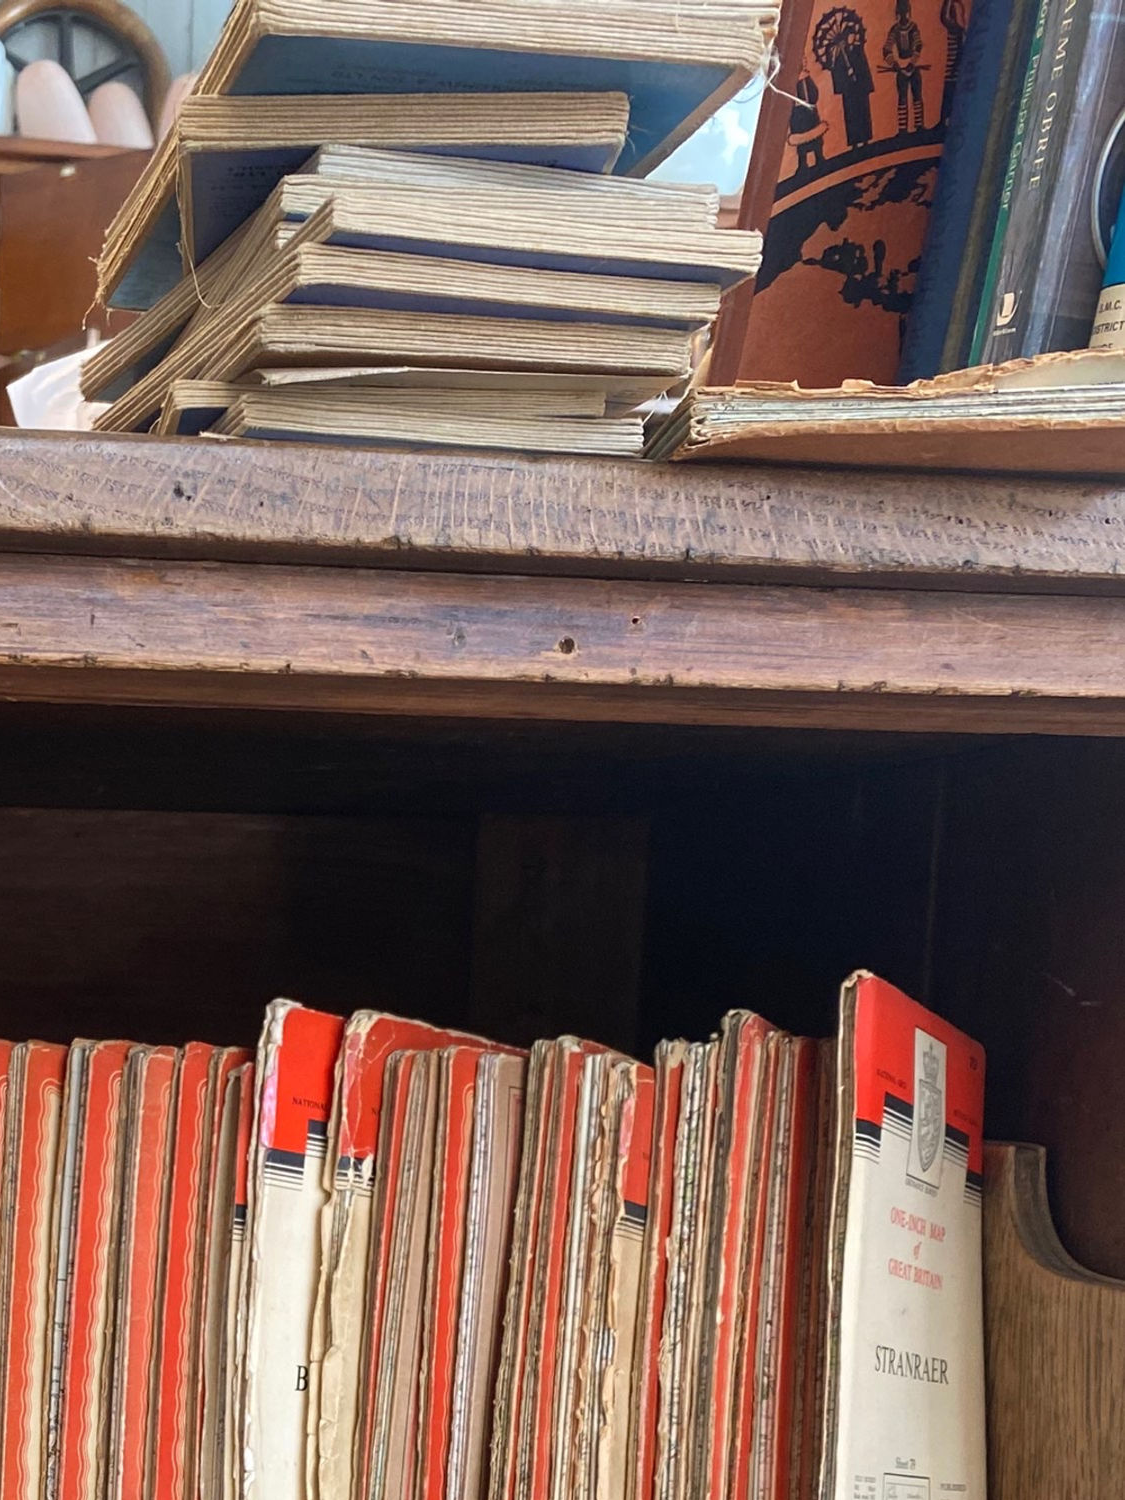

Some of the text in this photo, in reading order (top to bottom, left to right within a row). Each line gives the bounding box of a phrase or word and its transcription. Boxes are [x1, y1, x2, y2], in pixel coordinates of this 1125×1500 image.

[1001, 141, 1022, 211] Garner
[1028, 92, 1058, 191] OBREE
[874, 1344, 950, 1385] STRANRAER
